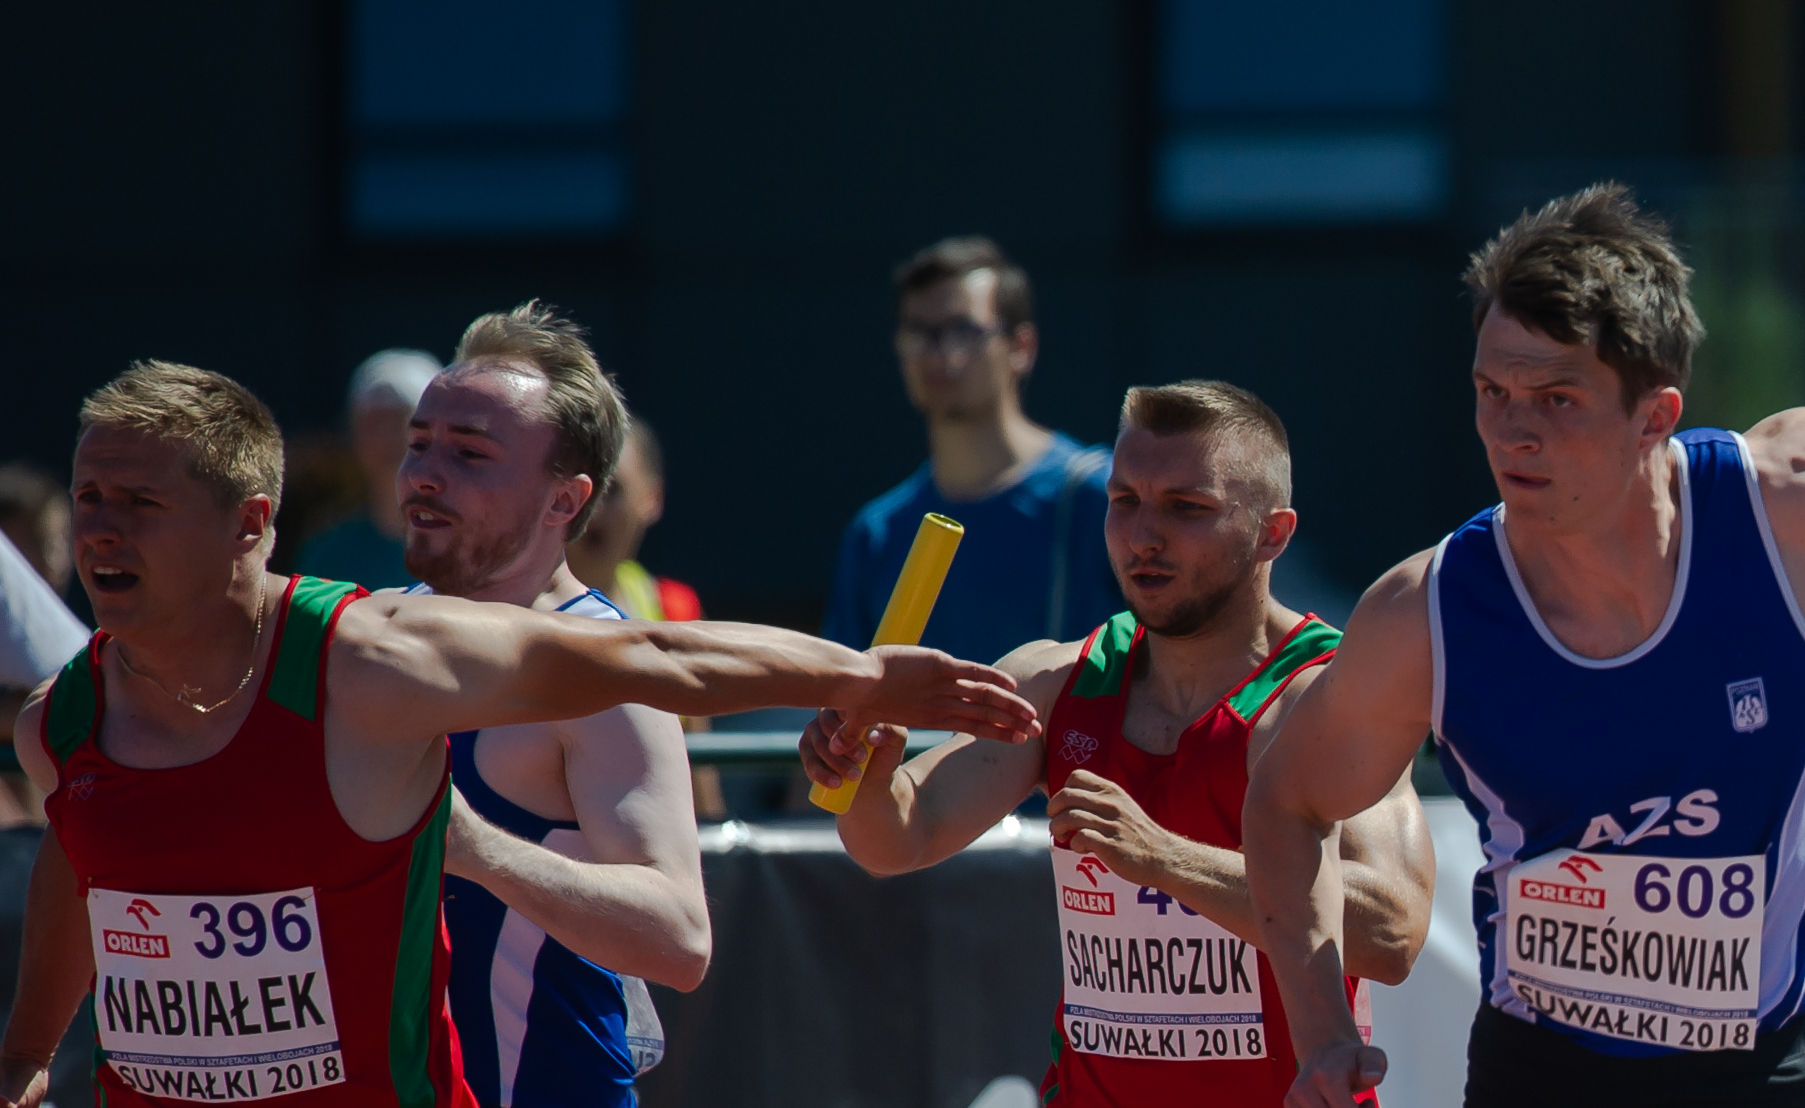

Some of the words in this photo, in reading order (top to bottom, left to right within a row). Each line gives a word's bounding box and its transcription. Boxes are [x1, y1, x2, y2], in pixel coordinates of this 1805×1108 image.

[1577, 788, 1721, 850] AZS
[1065, 890, 1110, 912] ORLEN
[1524, 881, 1600, 907] ORLEN
[1634, 862, 1755, 919] 608
[107, 933, 165, 955] ORLEN
[189, 895, 312, 959] 396
[1516, 913, 1750, 992] GRZEŚKOWIAK
[1067, 930, 1252, 995] SACHARCZUK
[104, 971, 326, 1037] NABIAŁEK
[1241, 1014, 1257, 1023] 2018
[1517, 984, 1668, 1043] SUWAŁKI
[1679, 1020, 1750, 1048] 2018
[1070, 1020, 1186, 1058] SUWAŁKI
[1195, 1028, 1263, 1057] 2018
[118, 1065, 258, 1100] SUWAŁKI
[268, 1056, 340, 1094] 2018
